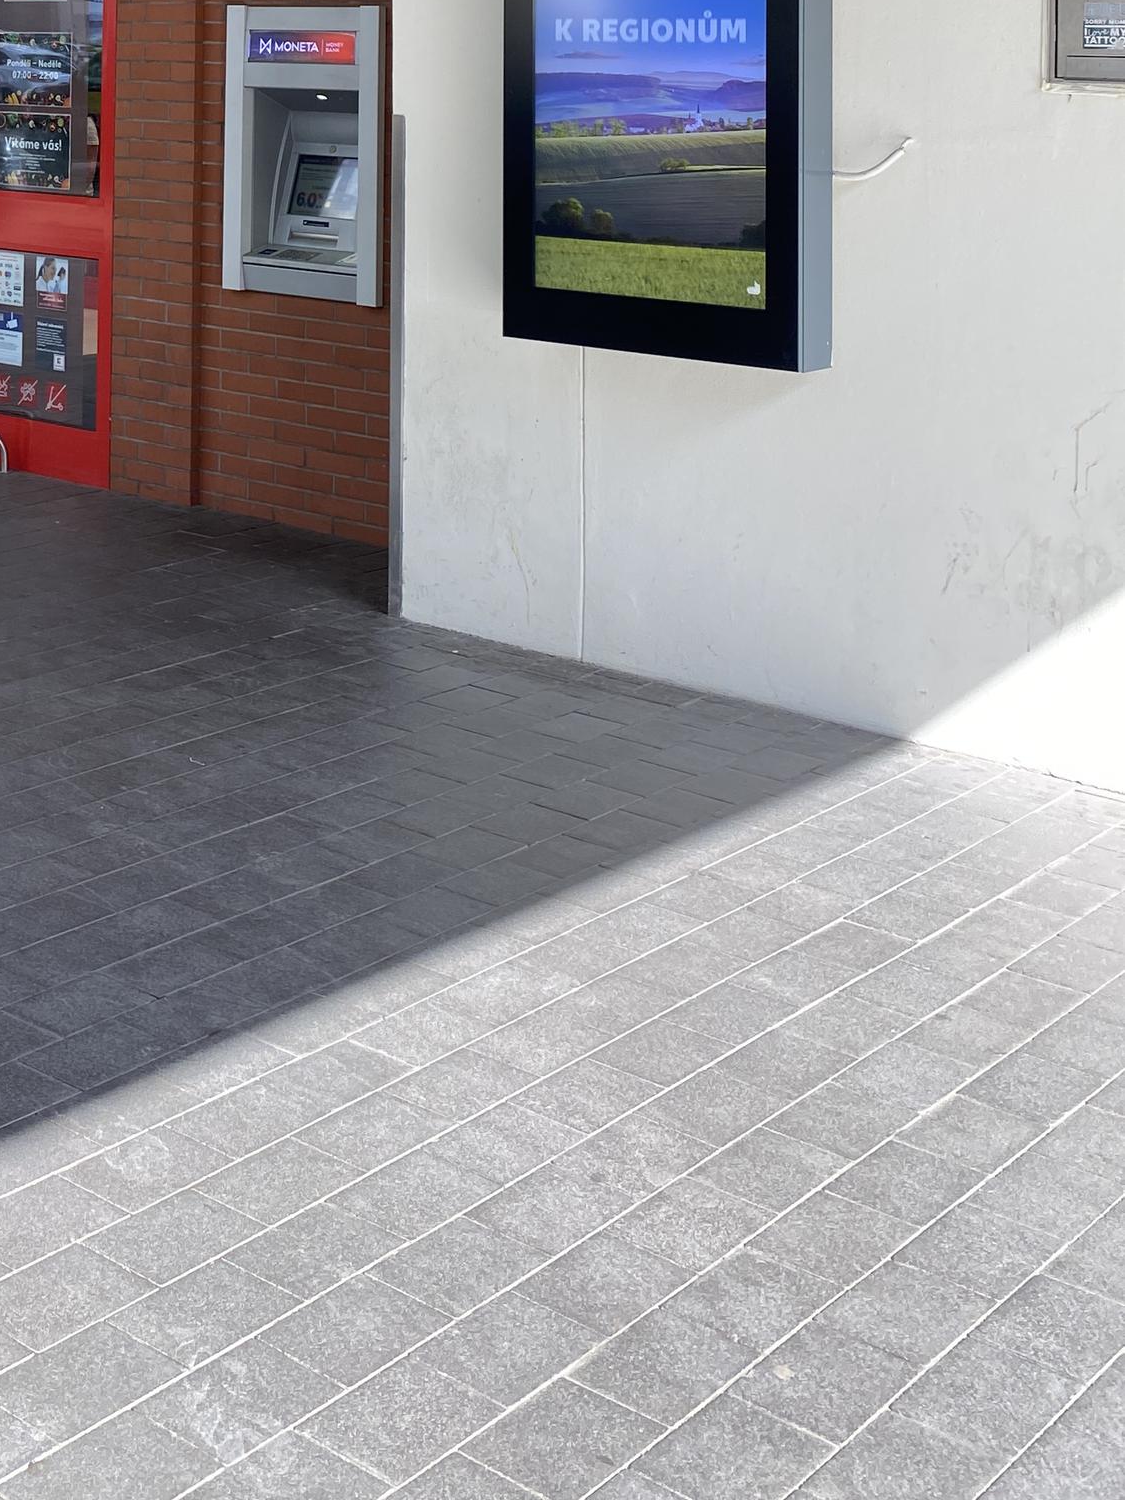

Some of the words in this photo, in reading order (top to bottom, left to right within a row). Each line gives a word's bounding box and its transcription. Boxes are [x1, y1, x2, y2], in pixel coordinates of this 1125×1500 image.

[555, 18, 573, 42] K
[582, 10, 747, 43] REGIONŮM
[275, 41, 319, 53] MONETA
[12, 71, 31, 79] 07:00
[38, 71, 59, 80] 22:00
[4, 136, 40, 150] Vítáme
[42, 139, 62, 151] vás!
